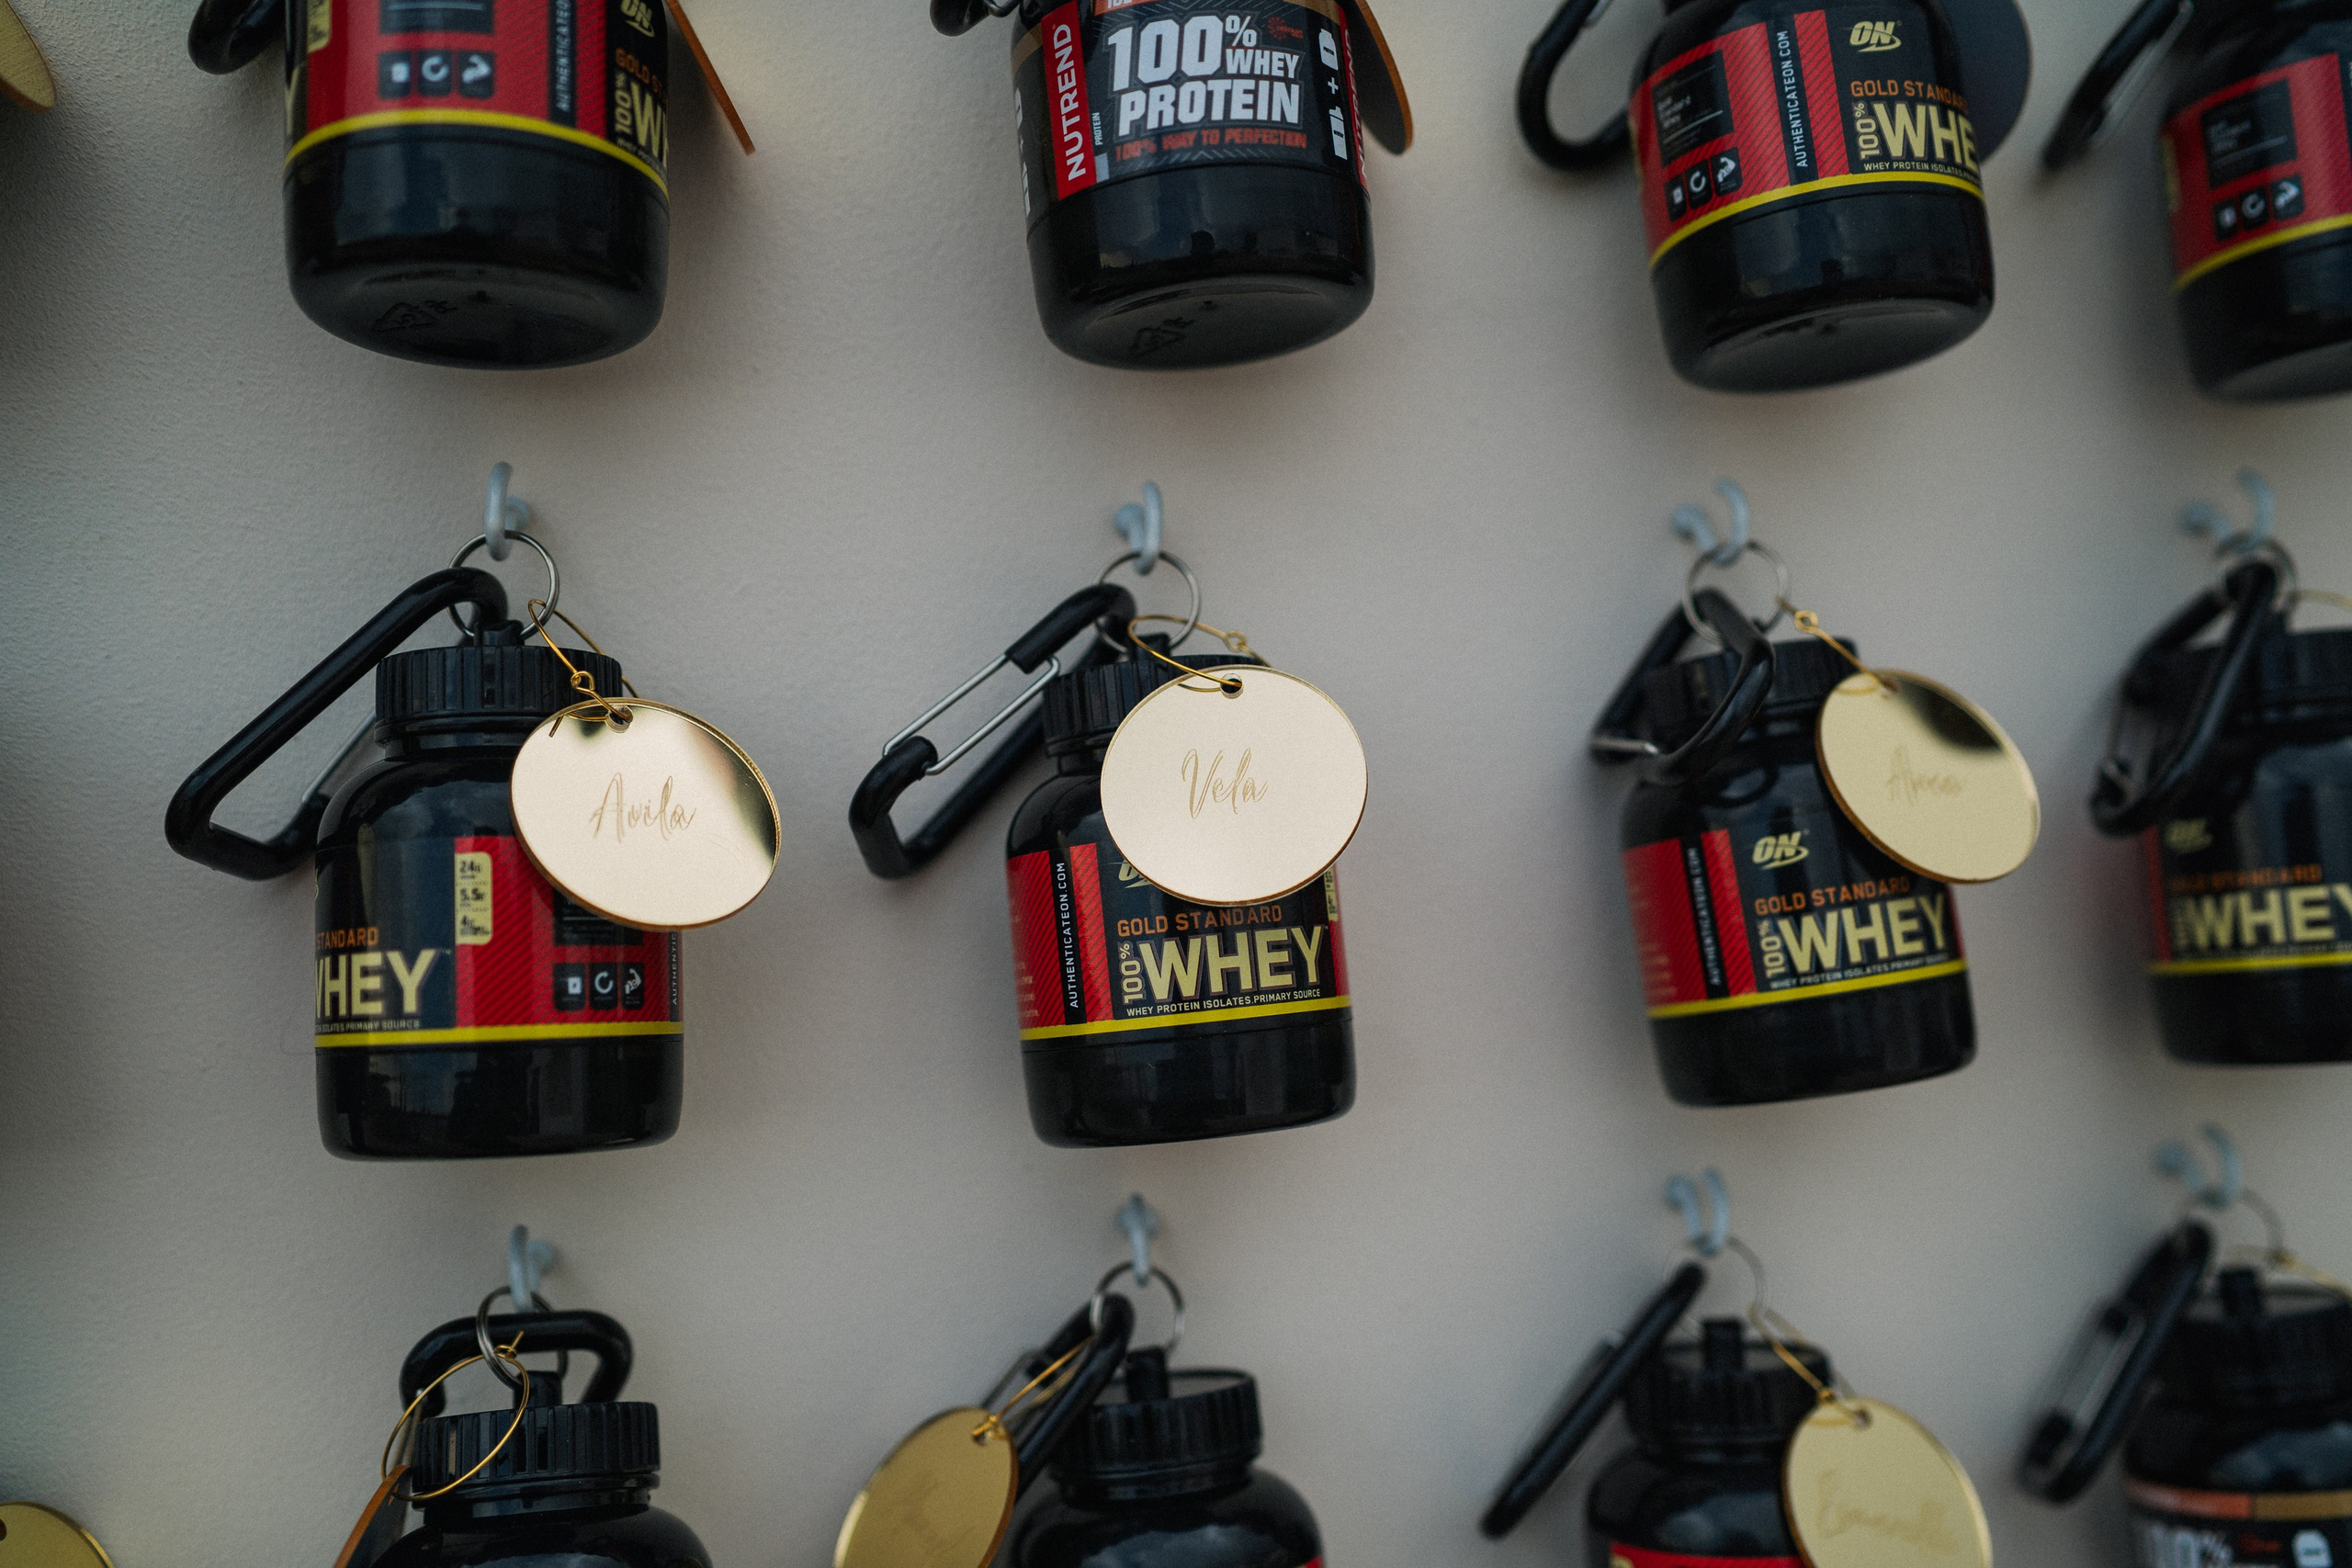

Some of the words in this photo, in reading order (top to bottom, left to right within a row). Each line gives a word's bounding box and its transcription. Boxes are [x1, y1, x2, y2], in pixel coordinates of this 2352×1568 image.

[1107, 15, 1258, 92] 100%
[1225, 48, 1299, 79] WHEY
[1849, 20, 1902, 52] ON
[1054, 24, 1086, 181] NUTREND
[1117, 79, 1300, 137] PROTEIN
[1776, 30, 1808, 167] AUTHENTICATEON.COM
[1850, 80, 1899, 97] GOLD
[1092, 112, 1103, 146] PROTEIN
[1161, 131, 1198, 151] WAY
[1201, 129, 1221, 145] TO
[1224, 128, 1307, 149] PERFECTION
[1854, 102, 1881, 160] 100%
[1864, 162, 1891, 171] WHEY
[1893, 162, 1929, 171] PROTEIN
[1181, 747, 1269, 819] Vela
[1752, 830, 1809, 871] ON
[1117, 915, 1169, 937] GOLD
[1175, 905, 1283, 931] STANDARD
[1755, 892, 1806, 917] GOLD
[1811, 876, 1910, 908] STANDARD
[1057, 863, 1079, 1008] AUTHENTICATEON.COM
[1758, 919, 1786, 978] 100%
[1777, 893, 1946, 975] WHEY
[1119, 942, 1144, 1003] 100%
[1138, 925, 1323, 1001] WHEY
[1126, 1006, 1153, 1017] WHEY
[1157, 1001, 1201, 1014] PROTEIN
[1293, 988, 1321, 1001] SOURCE
